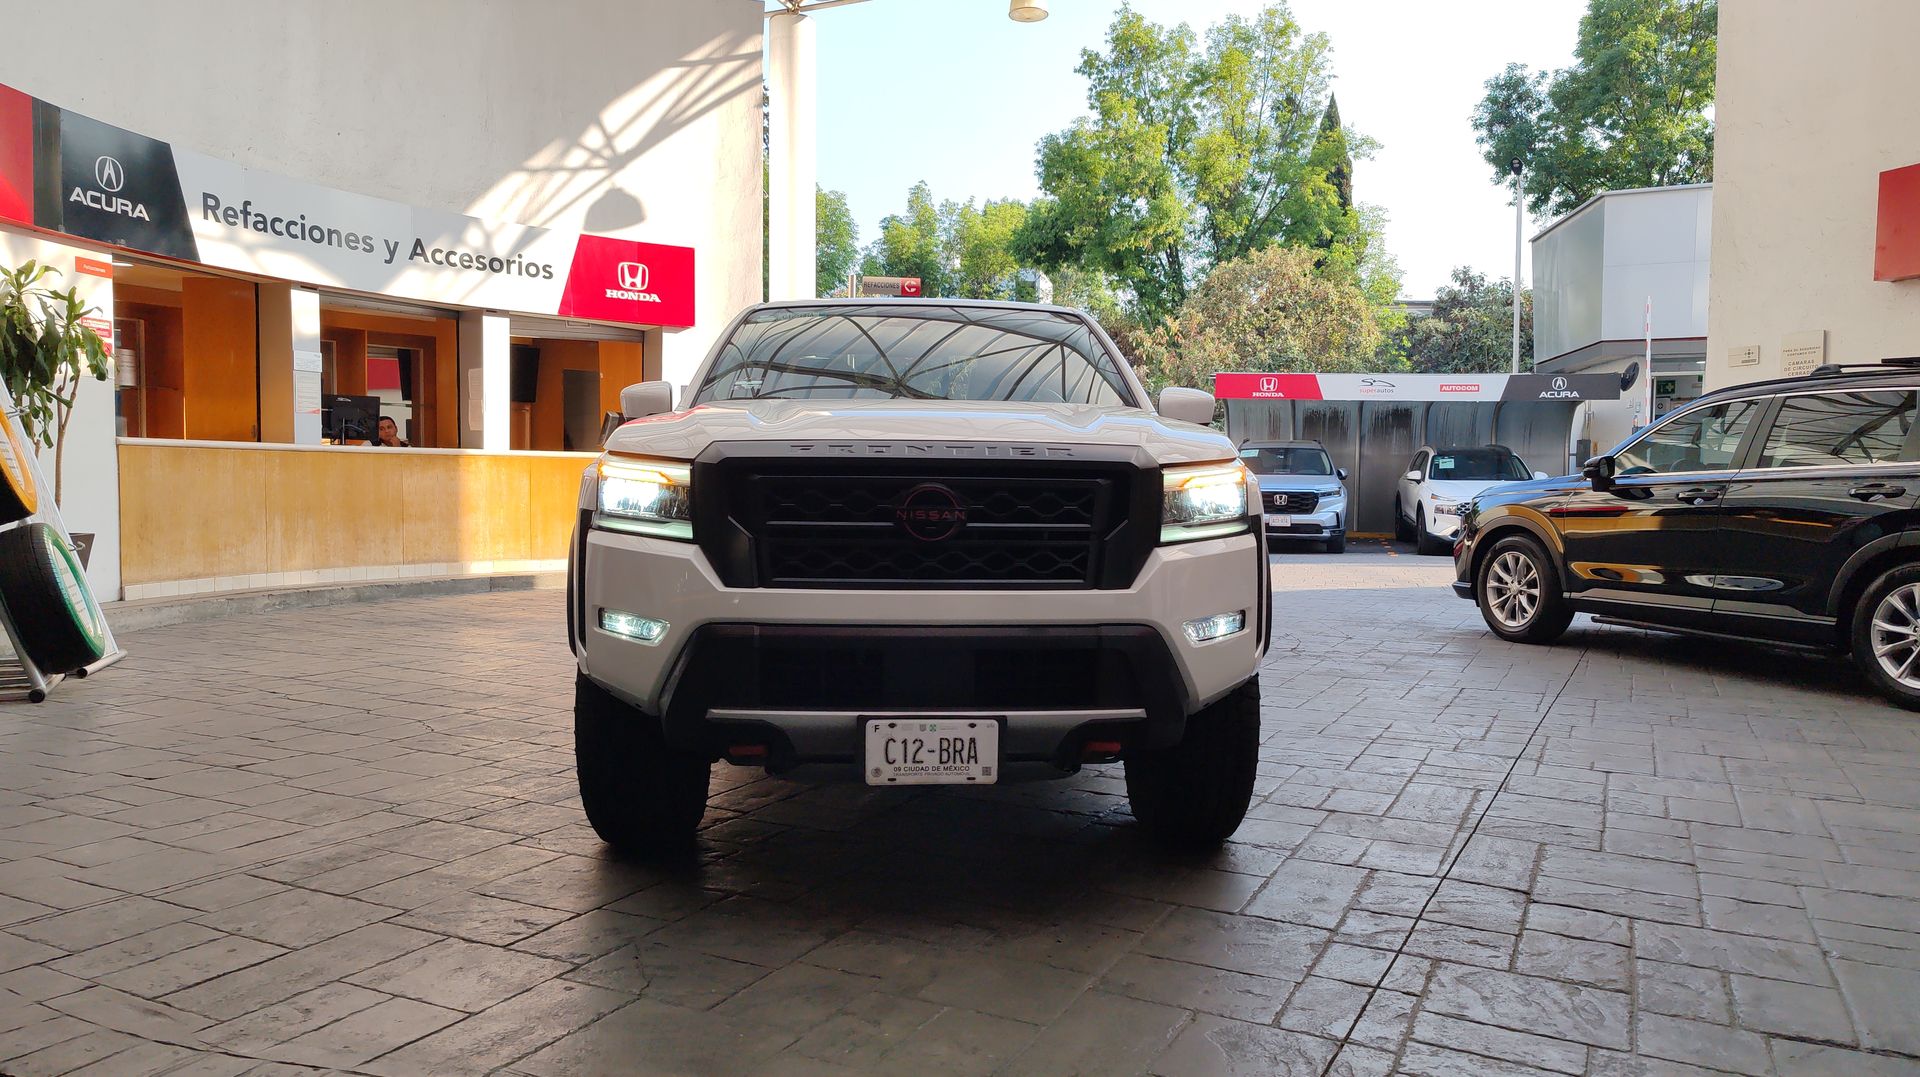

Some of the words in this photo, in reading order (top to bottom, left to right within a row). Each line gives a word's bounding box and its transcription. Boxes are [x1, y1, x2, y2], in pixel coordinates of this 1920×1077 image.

[69, 186, 150, 222] ACURA
[202, 191, 375, 253] Refacciones
[383, 238, 400, 264] y
[408, 237, 554, 280] Accesorios
[605, 288, 661, 303] HONDA
[789, 444, 1076, 457] FRONTIER
[896, 509, 967, 521] NISSAN
[874, 724, 880, 733] F
[884, 737, 978, 765] C12-BRA
